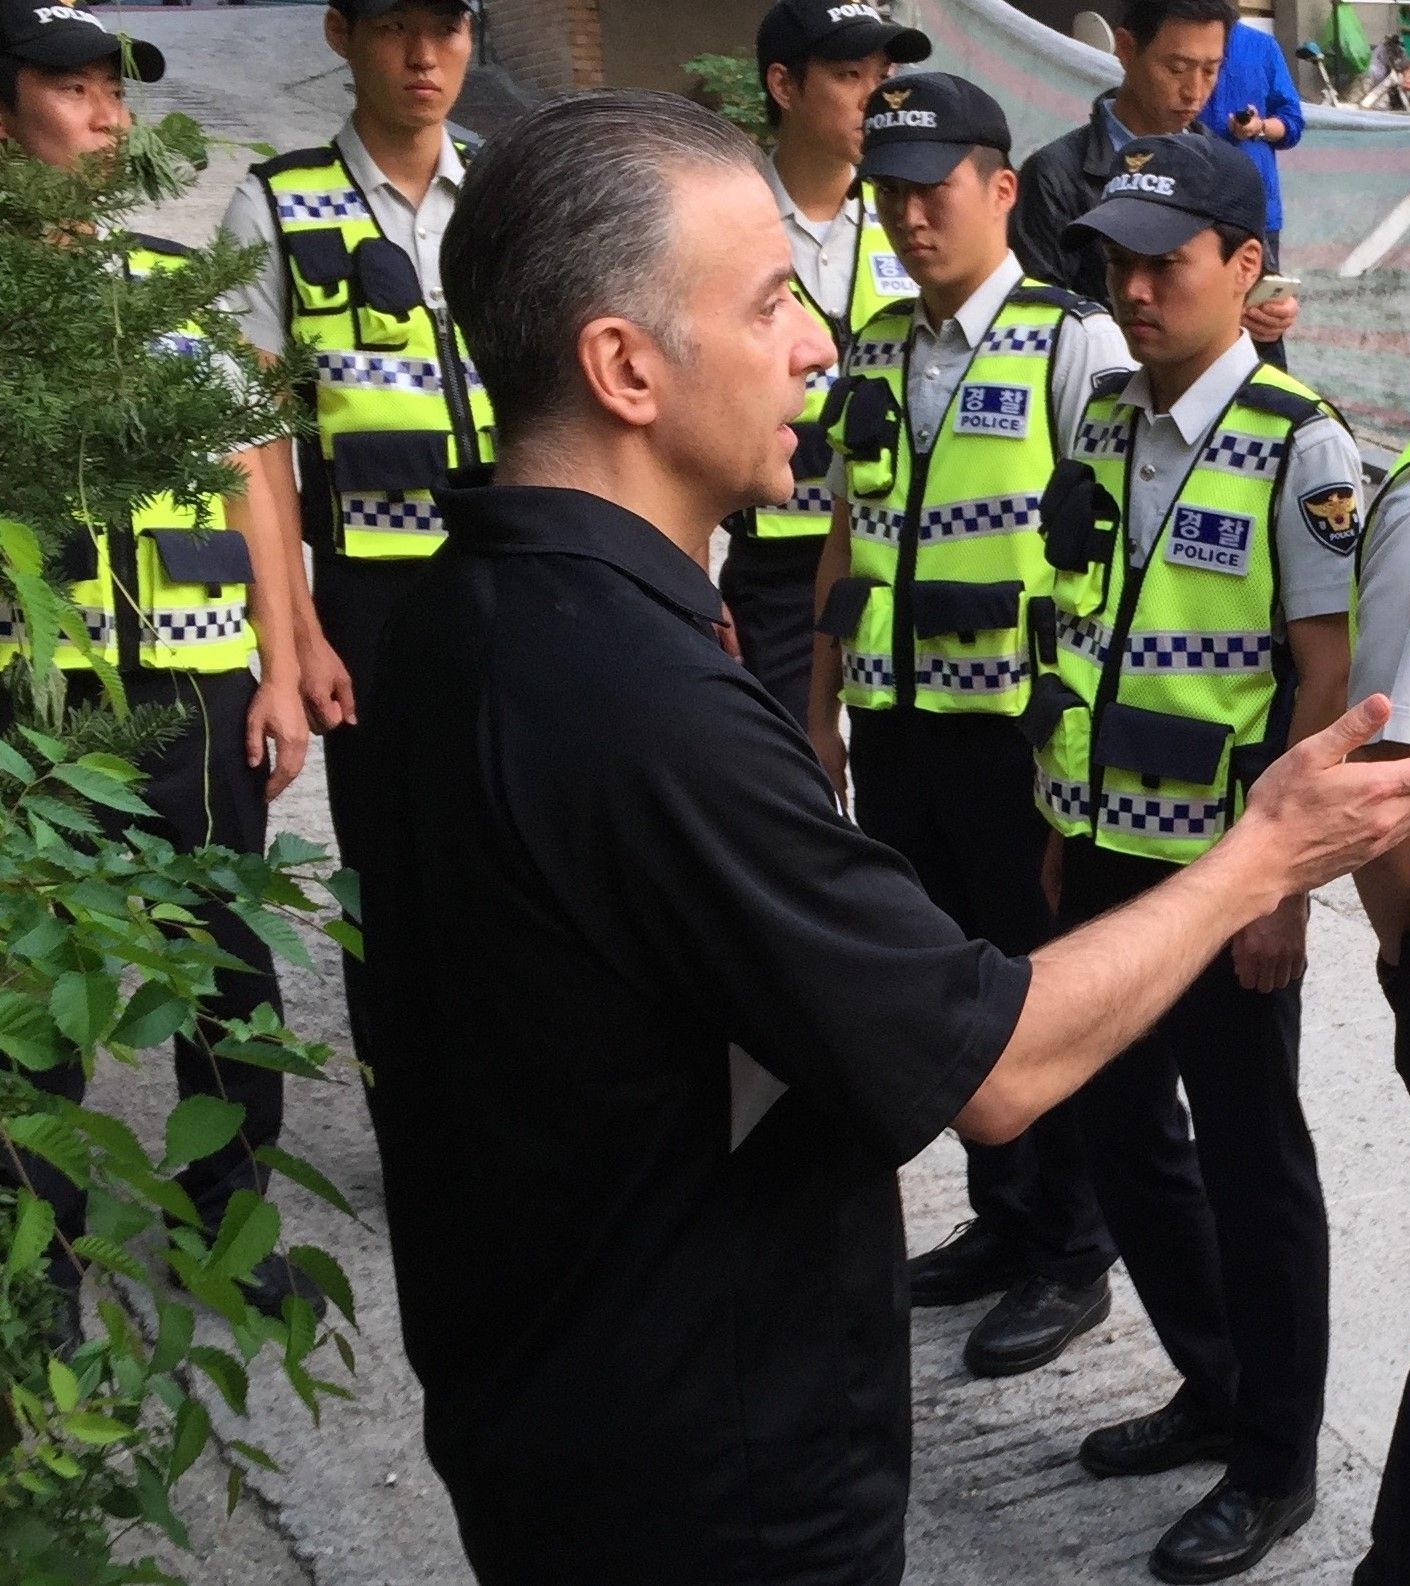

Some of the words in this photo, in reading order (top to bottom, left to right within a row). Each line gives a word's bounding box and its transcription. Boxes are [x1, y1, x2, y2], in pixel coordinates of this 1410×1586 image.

[880, 280, 914, 291] POLI
[960, 415, 1020, 431] POLICE
[1173, 542, 1240, 567] POLICE
